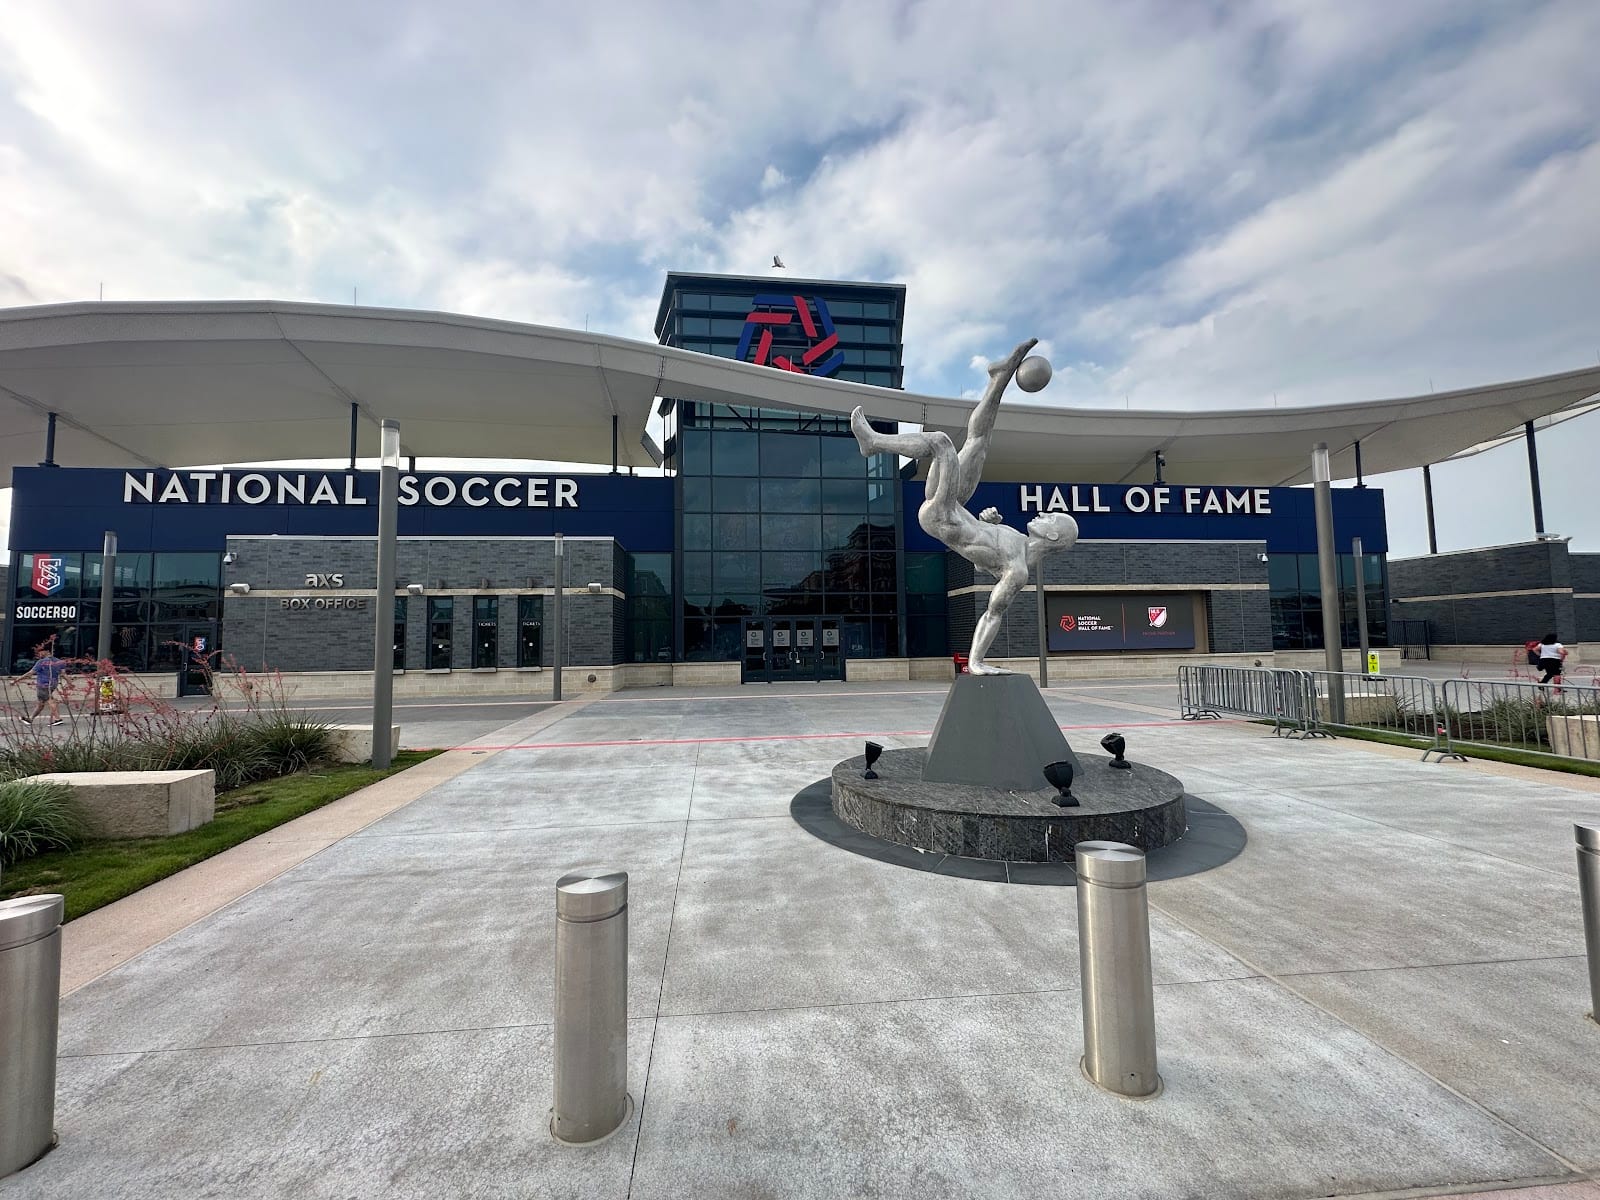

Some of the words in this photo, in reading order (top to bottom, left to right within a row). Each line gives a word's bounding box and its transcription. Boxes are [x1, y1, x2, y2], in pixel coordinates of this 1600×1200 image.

[123, 471, 367, 505] NATIONAL
[397, 475, 578, 508] SOCCER
[1020, 484, 1111, 512] HALL
[1124, 486, 1170, 513] OF
[1185, 487, 1272, 514] FAME
[304, 573, 345, 589] axs
[280, 598, 310, 609] BOX
[314, 598, 367, 609] OFFICE
[16, 605, 77, 619] SOCCER90
